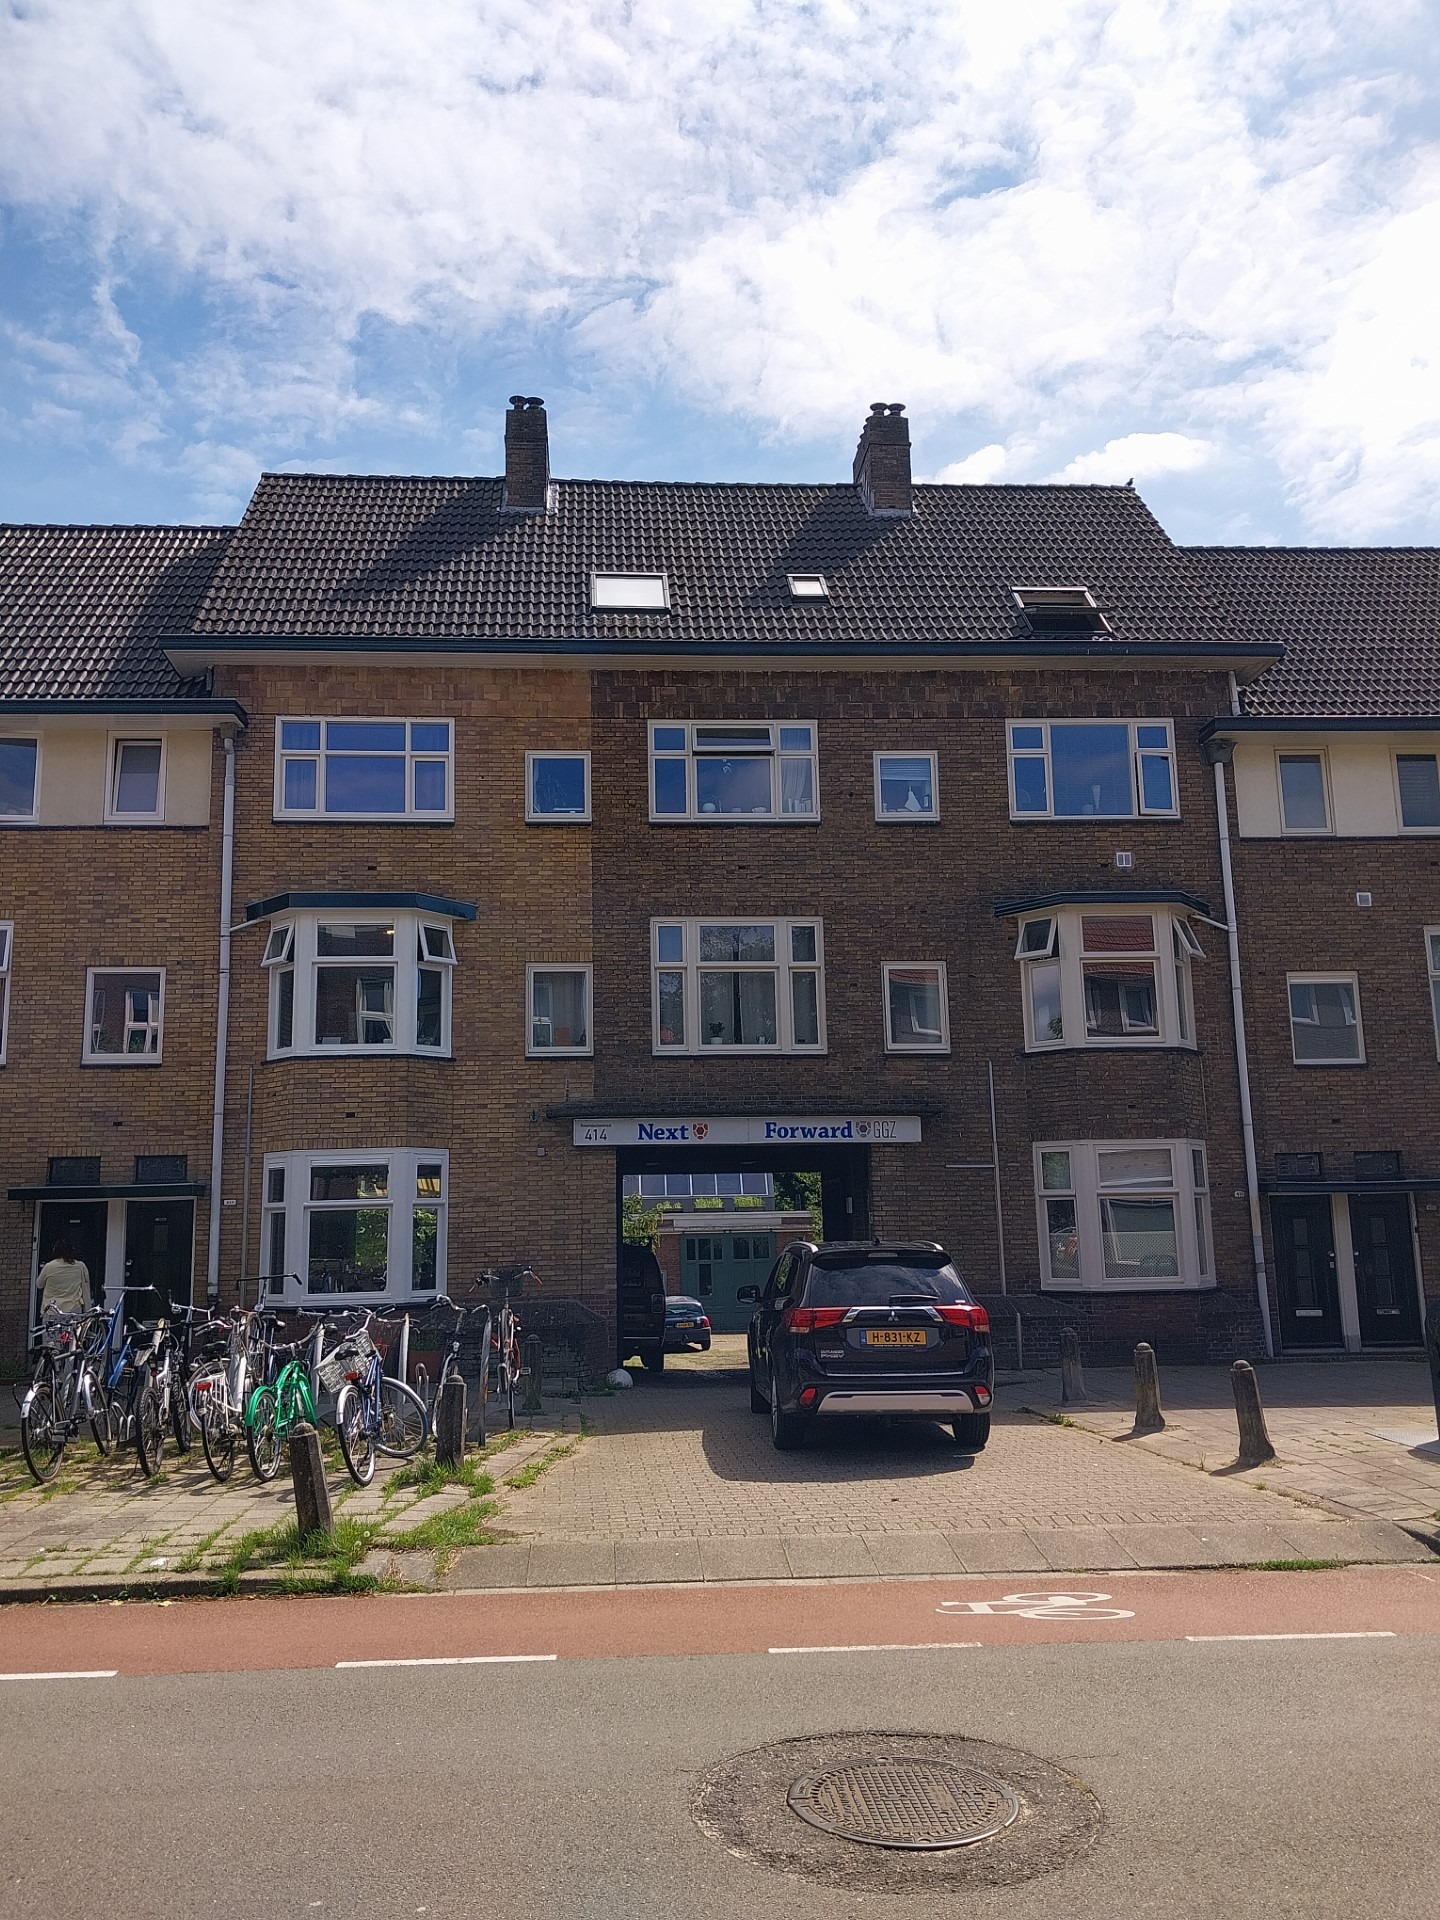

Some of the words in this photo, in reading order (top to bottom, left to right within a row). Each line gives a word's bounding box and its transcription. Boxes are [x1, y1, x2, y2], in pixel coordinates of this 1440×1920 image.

[584, 1128, 608, 1141] 414
[637, 1123, 689, 1140] Next
[764, 1121, 854, 1139] Forward
[873, 1120, 897, 1139] GGZ
[872, 1332, 921, 1343] H-831-KZ
